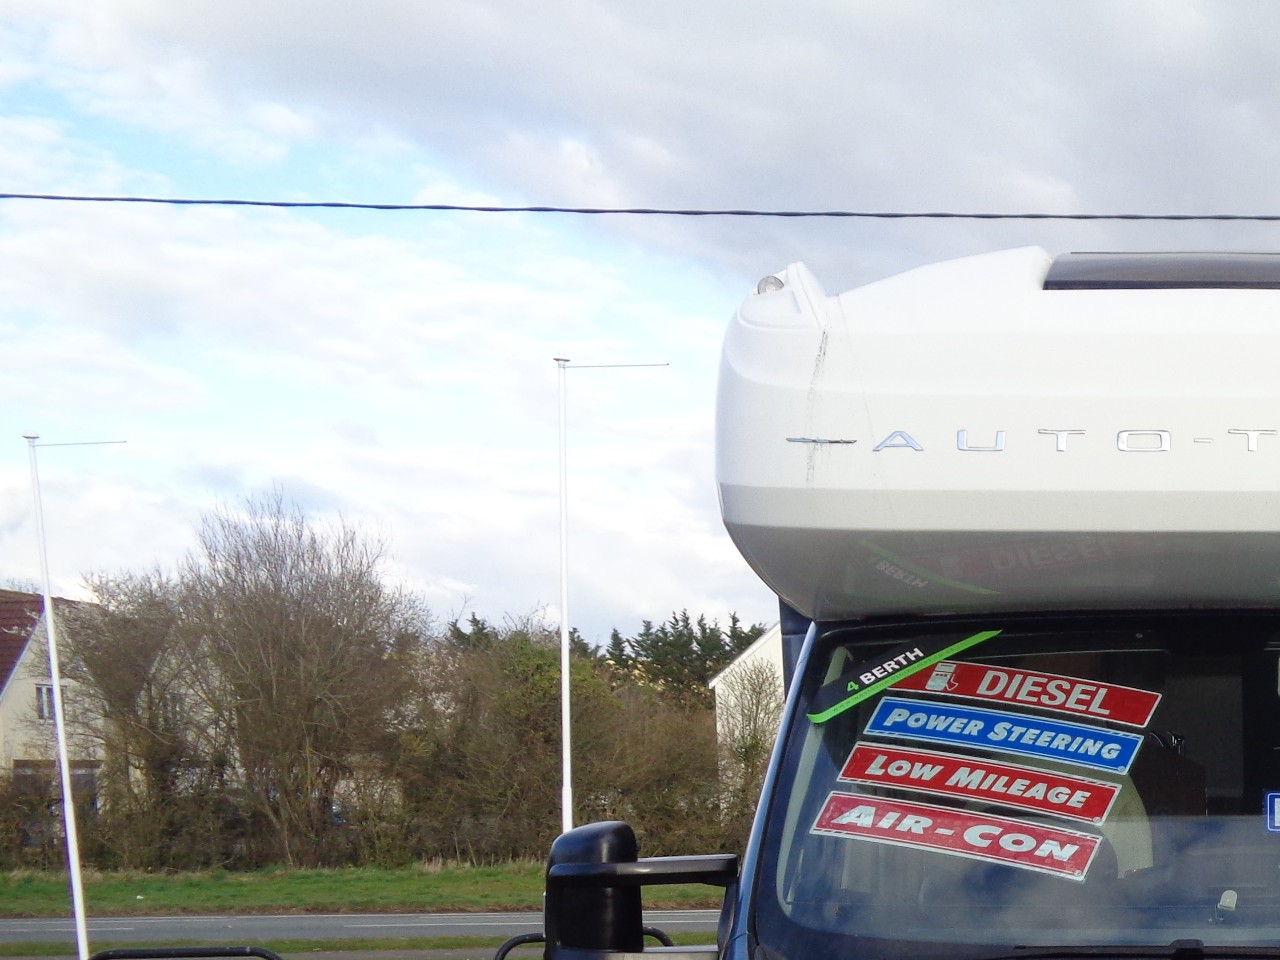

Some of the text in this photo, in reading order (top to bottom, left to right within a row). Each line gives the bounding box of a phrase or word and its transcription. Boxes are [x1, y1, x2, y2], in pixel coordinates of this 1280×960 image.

[846, 647, 925, 692] 4 BERTH
[977, 670, 1112, 716] DIESEL
[884, 708, 1122, 760] POWER STEERING
[864, 754, 1092, 809] LOW MILEAGE
[831, 805, 1080, 862] AIR-CON
